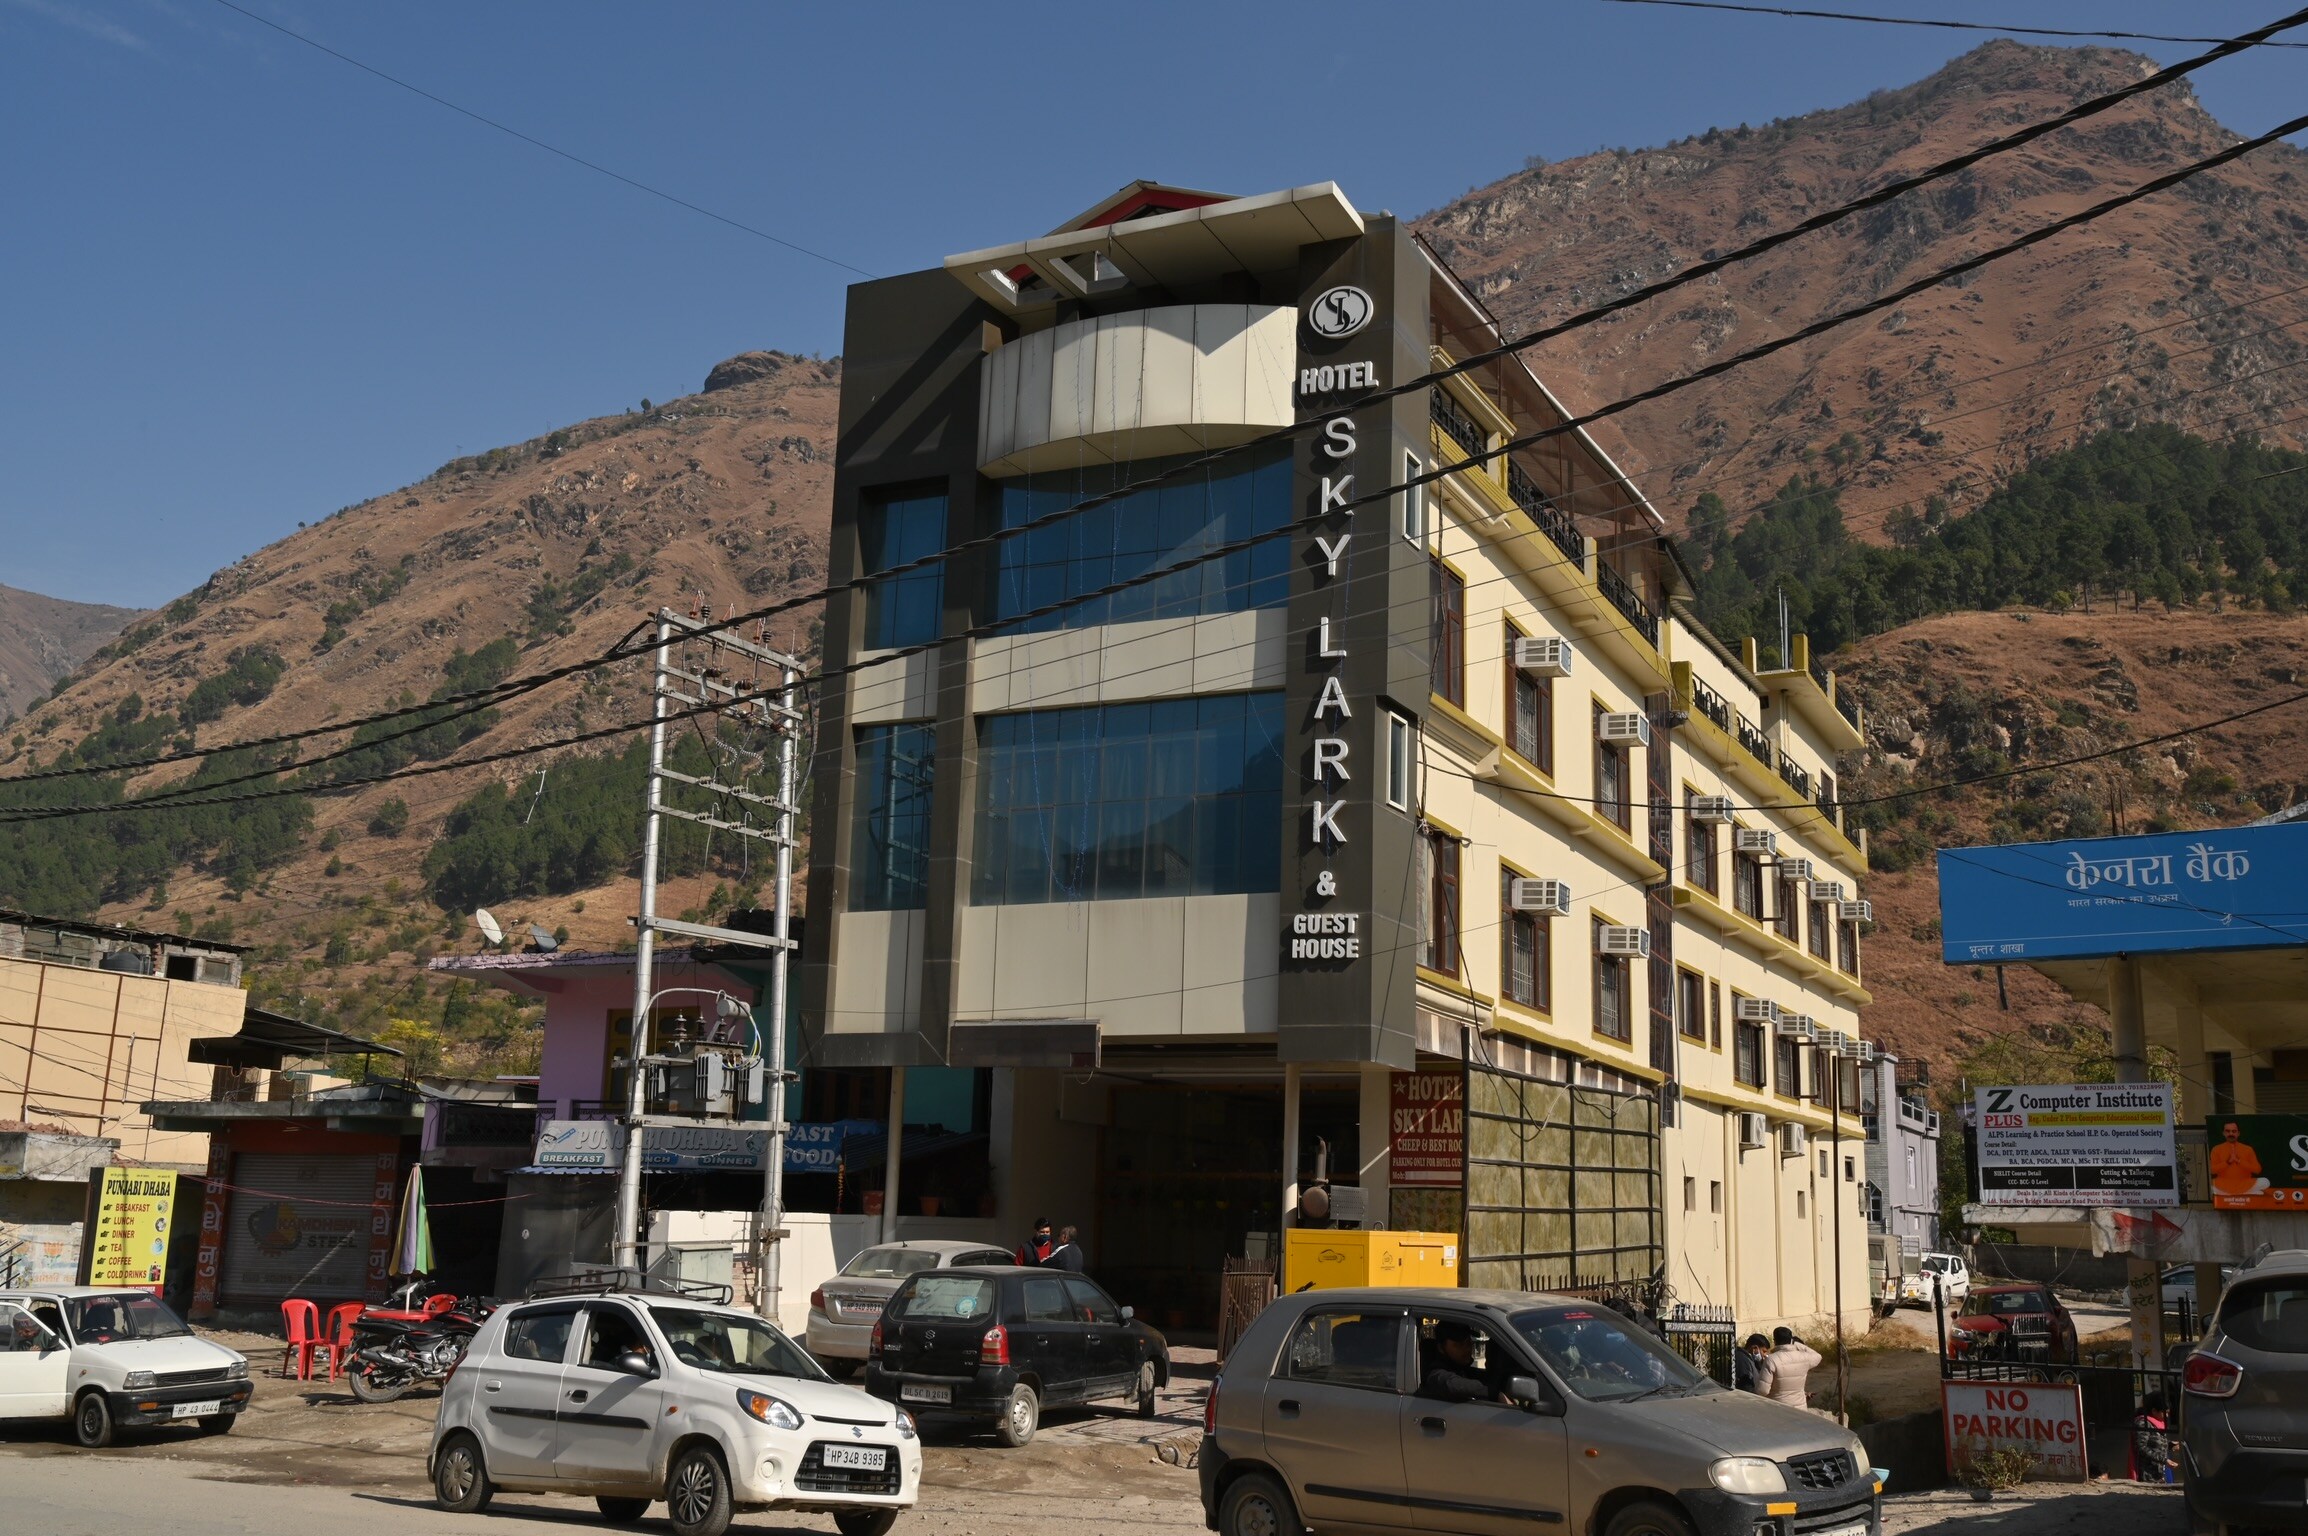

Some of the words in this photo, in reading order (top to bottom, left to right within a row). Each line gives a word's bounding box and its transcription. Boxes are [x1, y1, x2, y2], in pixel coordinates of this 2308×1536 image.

[1300, 361, 1380, 394] HOTEL
[2065, 851, 2173, 890] केनरा
[2186, 842, 2250, 883] बैंक
[1316, 870, 1336, 897] &
[2068, 897, 2090, 908] भारत
[2094, 896, 2125, 906] सरकार
[1293, 913, 1359, 934] GUEST
[1291, 938, 1359, 959] HOUSE
[2000, 943, 2024, 955] शाखा
[1408, 1075, 1463, 1101] HOTEL
[1987, 1089, 2014, 1113] Z
[2020, 1093, 2091, 1112] Computer
[2096, 1091, 2163, 1108] Institute
[1393, 1109, 1427, 1134] SKY
[1984, 1114, 2023, 1128] PLUS
[2140, 1113, 2161, 1123] Society
[667, 1129, 738, 1151] DHABA
[1988, 1131, 2005, 1139] ALPS
[2005, 1131, 2032, 1139] Learning
[2033, 1130, 2039, 1138] &
[2040, 1130, 2065, 1138] Practice
[2066, 1129, 2086, 1138] School
[2111, 1129, 2139, 1138] Operated
[2140, 1129, 2163, 1138] Society
[1397, 1139, 1420, 1152] CHEEP
[1421, 1139, 1428, 1150] &
[1430, 1140, 1446, 1152] BEST
[542, 1154, 602, 1164] BREAKFAST
[702, 1156, 753, 1165] DINNER
[2100, 1169, 2121, 1178] Cutting
[106, 1179, 141, 1196] PUNJABI
[142, 1181, 171, 1196] DHABA
[2122, 1179, 2151, 1187] Designing
[2075, 1190, 2101, 1198] Computer
[115, 1203, 150, 1212] BREAKFAST
[113, 1216, 135, 1225] LUNCH
[111, 1230, 135, 1239] DINNER
[110, 1243, 122, 1252] TEA
[307, 1235, 358, 1249] STEEL
[108, 1256, 132, 1265] COFFEE
[106, 1270, 124, 1279] COLD
[124, 1270, 147, 1279] DRINKS
[1985, 1390, 2029, 1412] NO
[177, 1406, 187, 1415] HP
[1953, 1414, 2077, 1444] PARKING
[830, 1450, 842, 1463] HP
[843, 1451, 860, 1465] 34B
[862, 1453, 884, 1466] 9385
